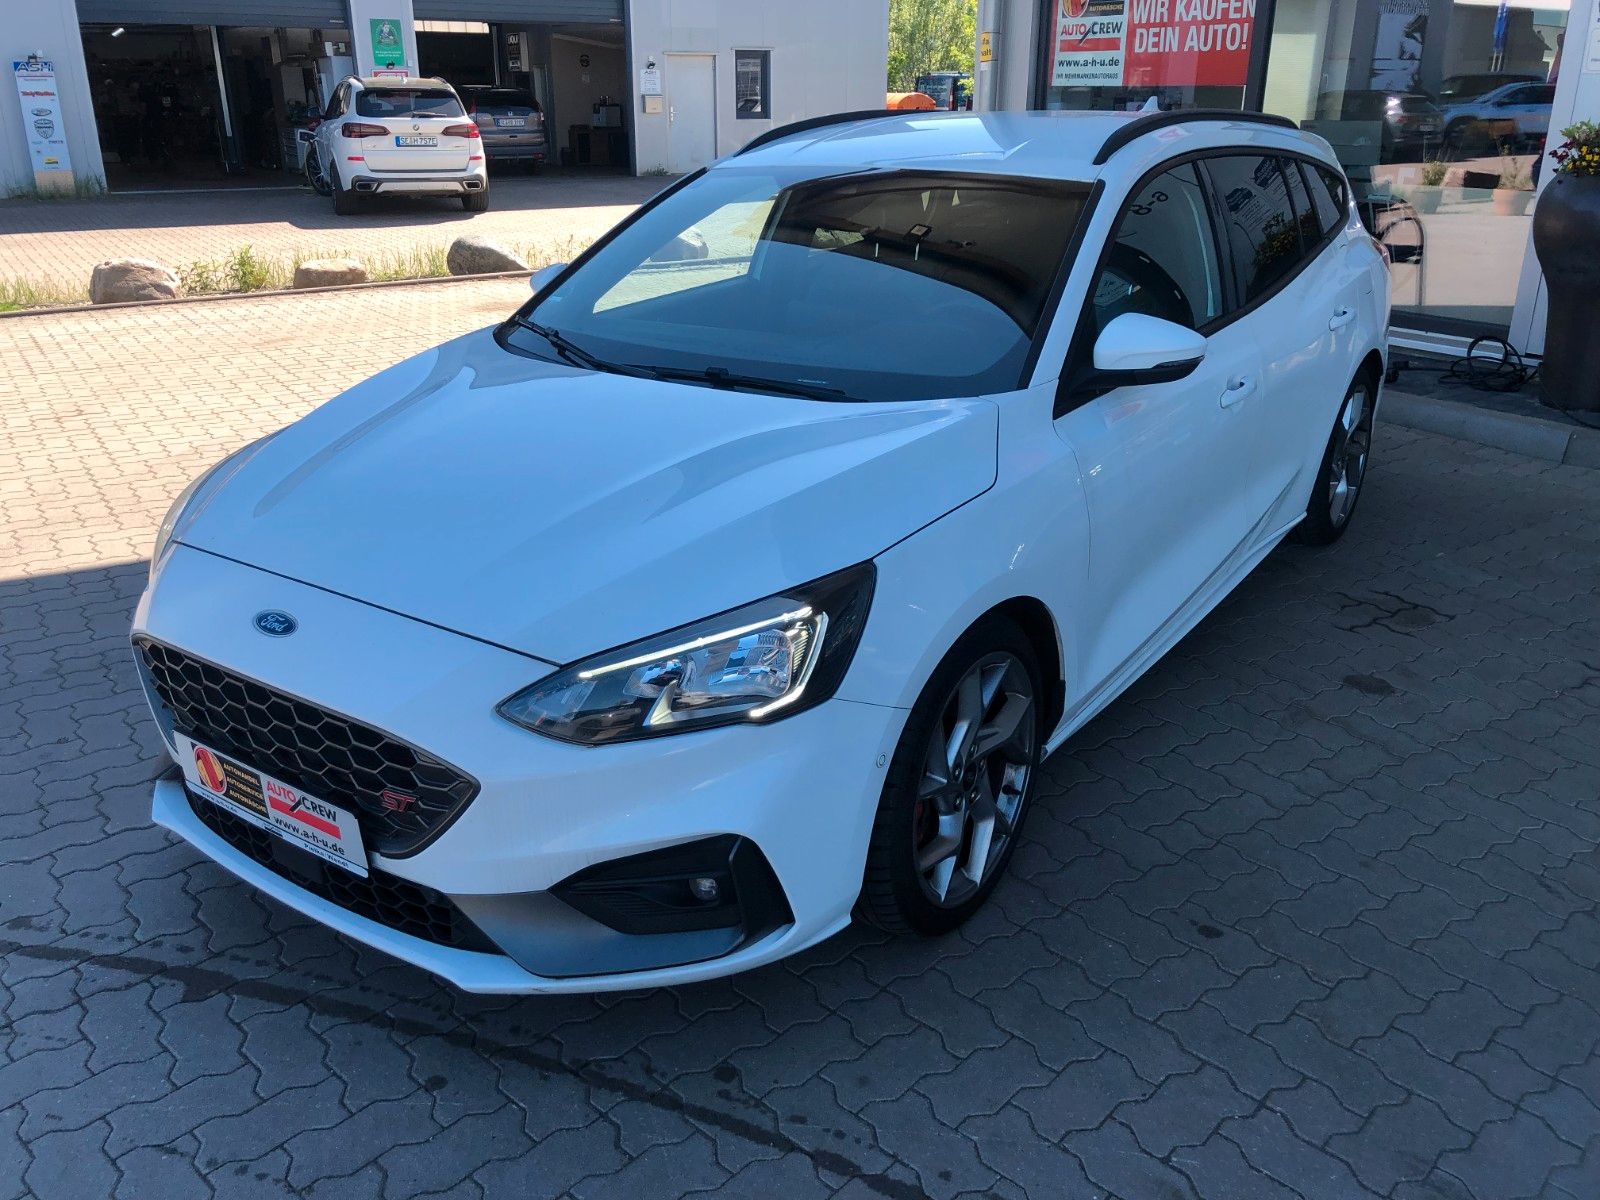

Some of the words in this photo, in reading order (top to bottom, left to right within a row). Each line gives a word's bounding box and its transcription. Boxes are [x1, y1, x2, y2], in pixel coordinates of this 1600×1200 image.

[1133, 0, 1169, 24] WIR
[1174, 0, 1257, 22] KAUFEN
[1061, 24, 1087, 36] AUTO
[1091, 21, 1123, 35] CREW
[1134, 27, 1179, 53] DEIN
[1184, 23, 1249, 52] AUTO!
[1058, 56, 1120, 67] www.a-h-u.de
[266, 781, 297, 803] AUTO
[301, 796, 337, 822] CREW
[381, 789, 417, 813] ST
[273, 816, 346, 855] www.a-h-u.de
